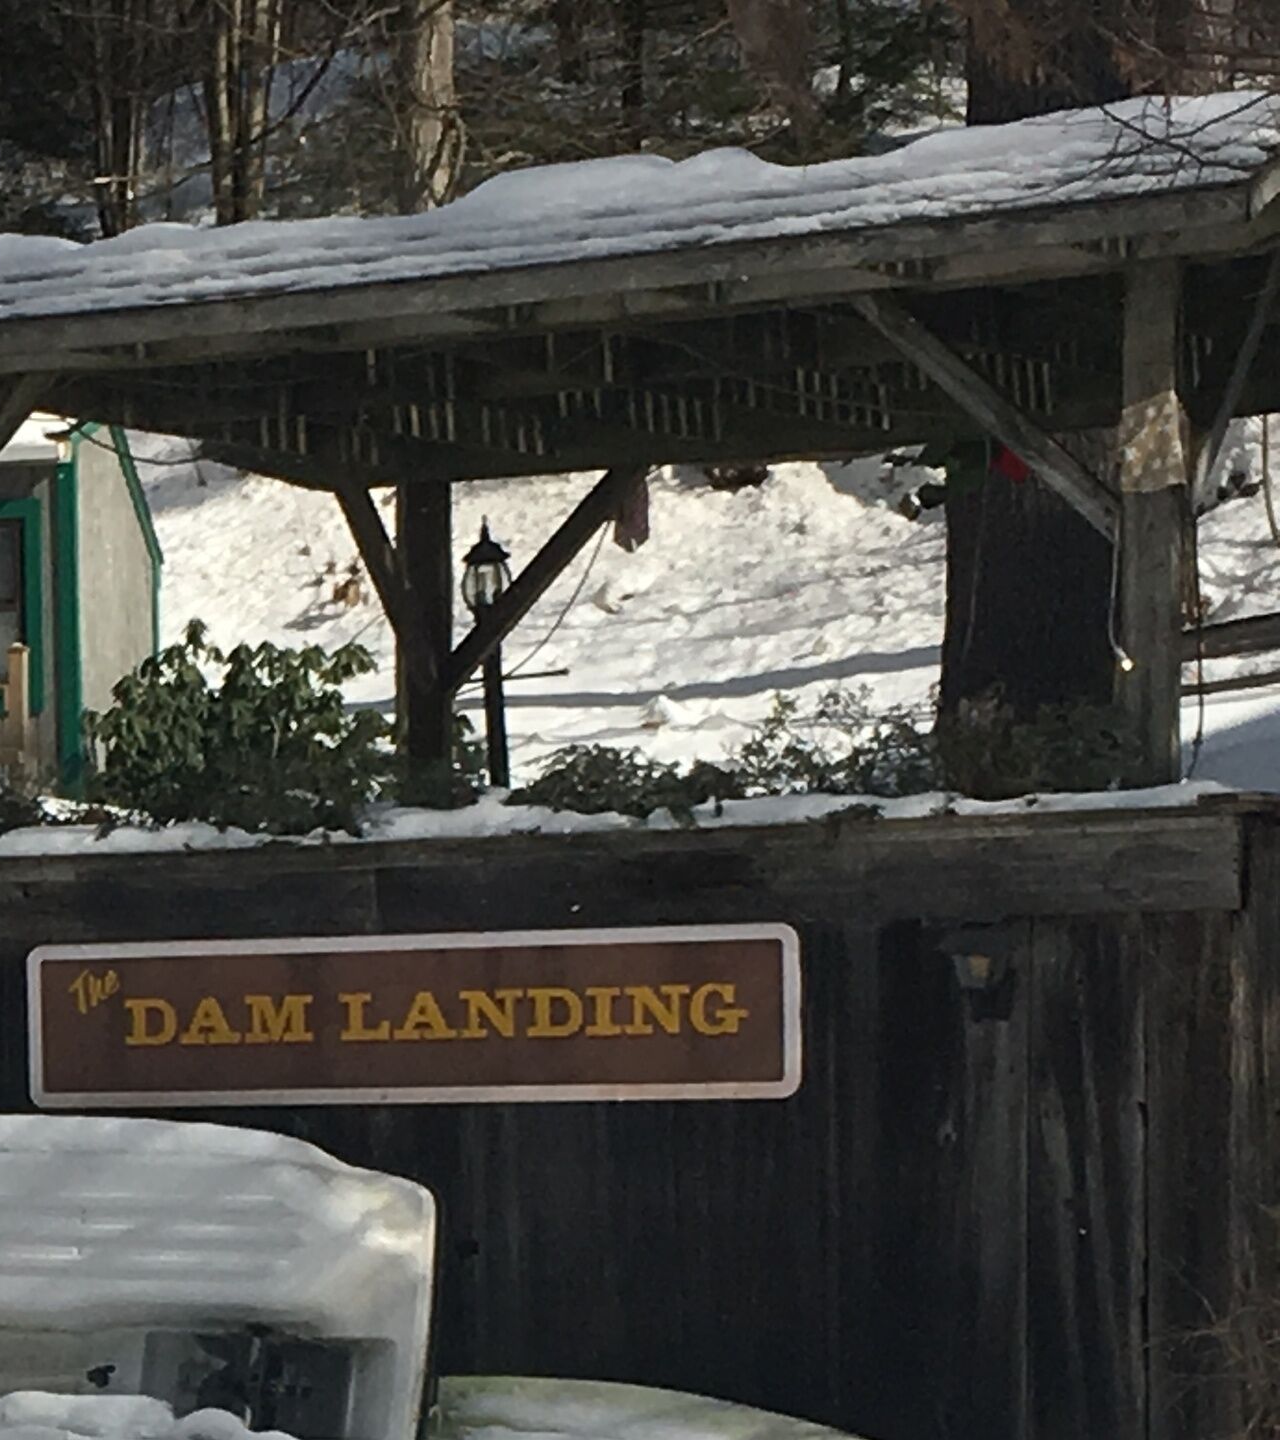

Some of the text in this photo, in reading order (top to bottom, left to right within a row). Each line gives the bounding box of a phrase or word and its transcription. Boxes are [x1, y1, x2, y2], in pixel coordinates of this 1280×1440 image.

[68, 969, 748, 1046] The DAM LANDING
